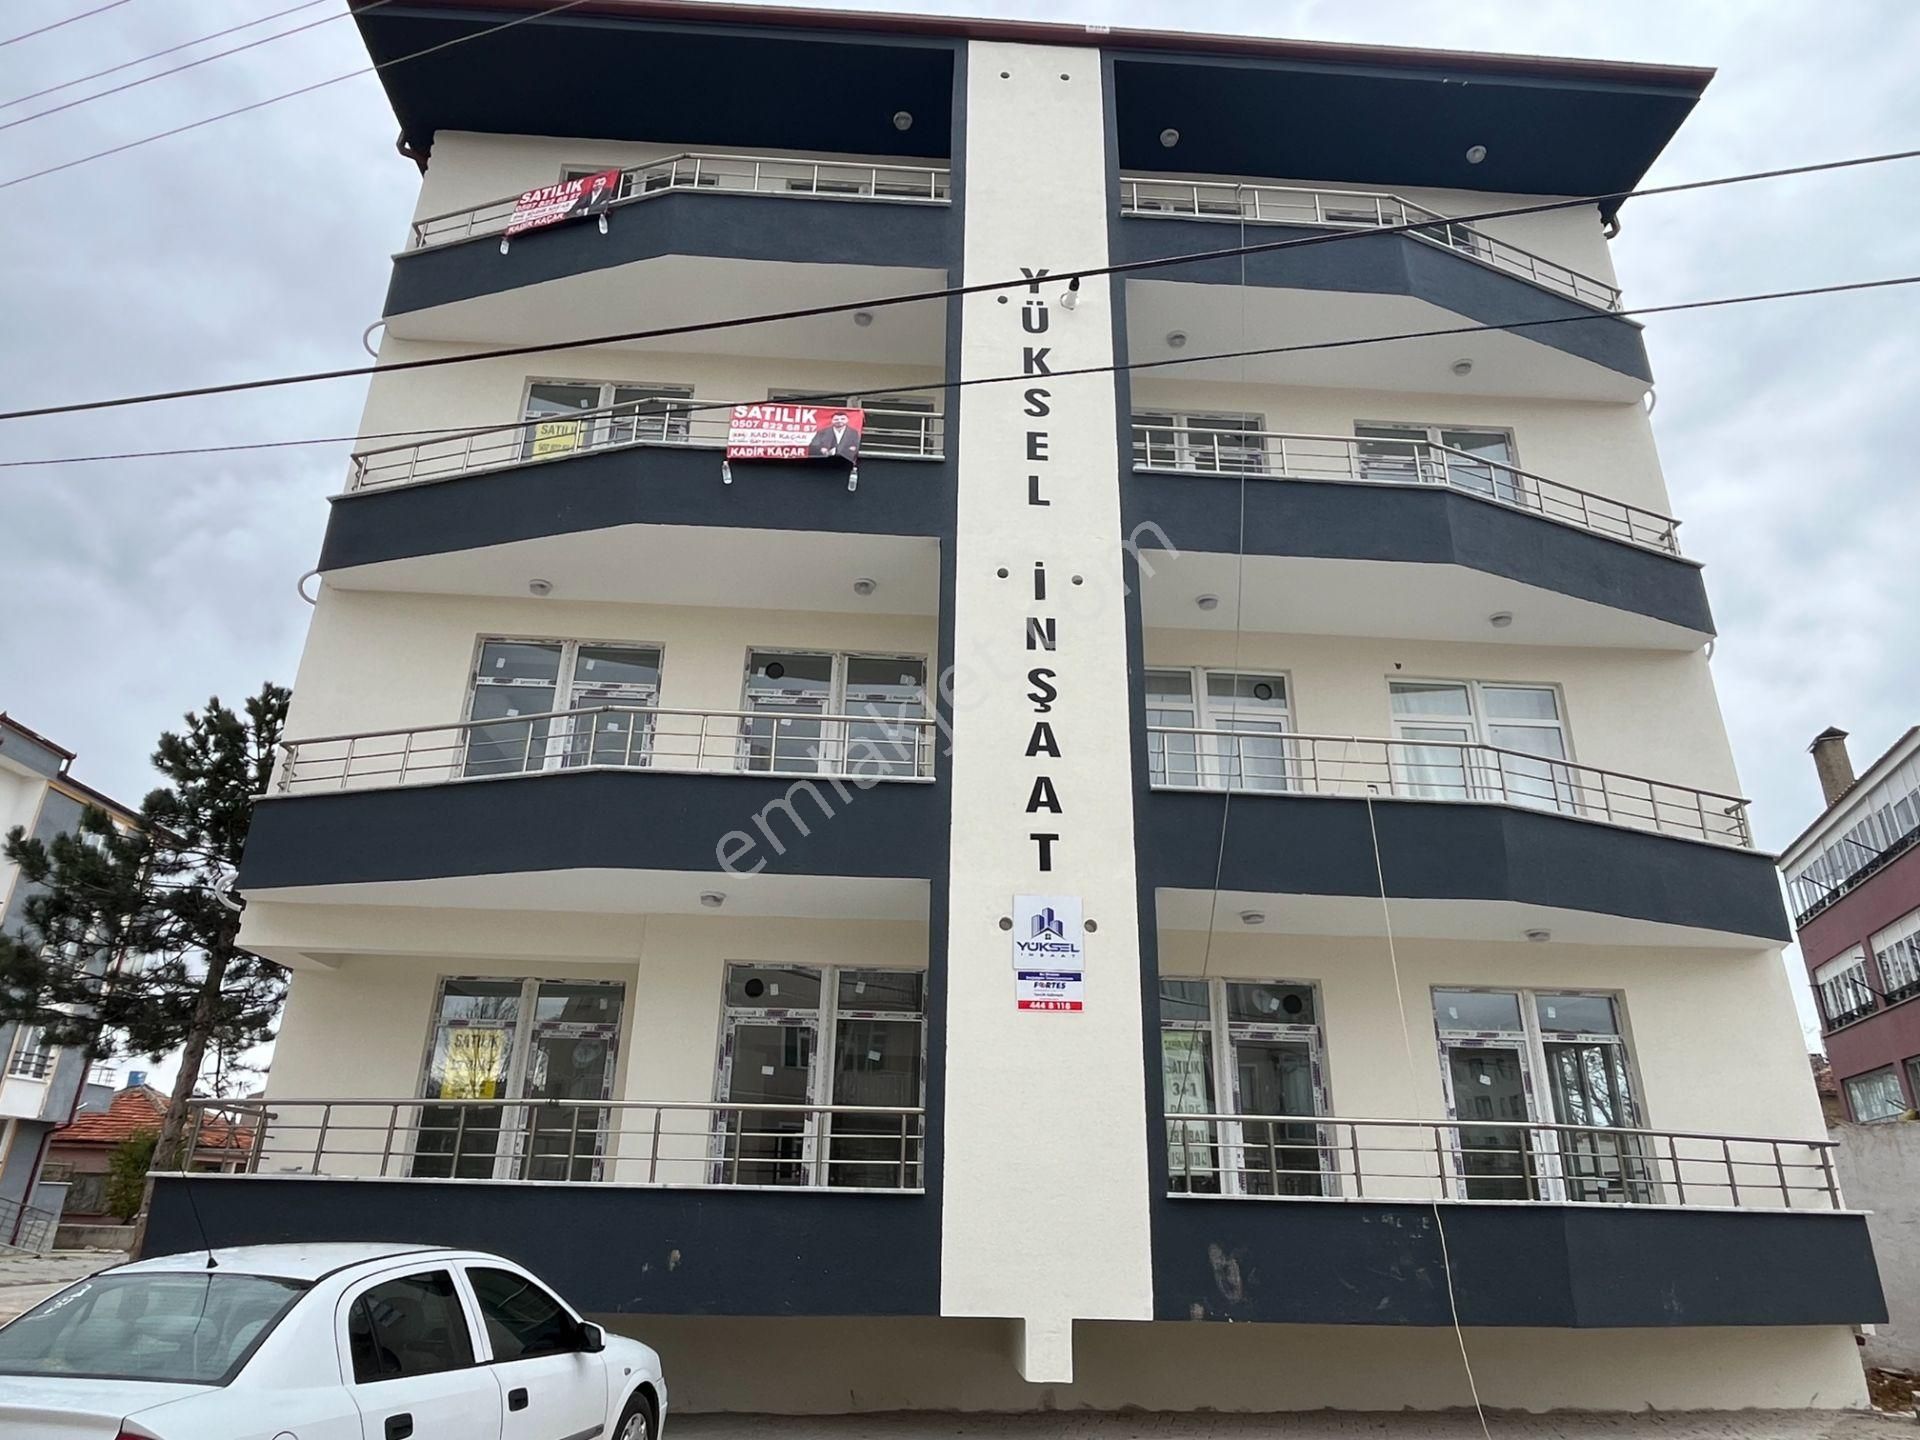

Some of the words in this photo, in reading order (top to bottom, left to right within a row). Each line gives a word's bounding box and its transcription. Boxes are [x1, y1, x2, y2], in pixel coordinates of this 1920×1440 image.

[520, 179, 584, 204] SATILIK
[1020, 267, 1051, 506] YÜKSEL
[734, 405, 817, 424] SATILIK
[541, 424, 578, 435] SATILI
[731, 419, 760, 429] 0507
[750, 431, 776, 439] KADİR
[779, 433, 807, 441] KAÇAR
[730, 445, 764, 456] KADİR
[766, 447, 805, 459] KAÇAR
[1025, 561, 1063, 872] İNŞAAT
[1016, 941, 1080, 953] YÜKSEL
[1029, 1001, 1046, 1009] 444
[1172, 1082, 1197, 1097] 3+1
